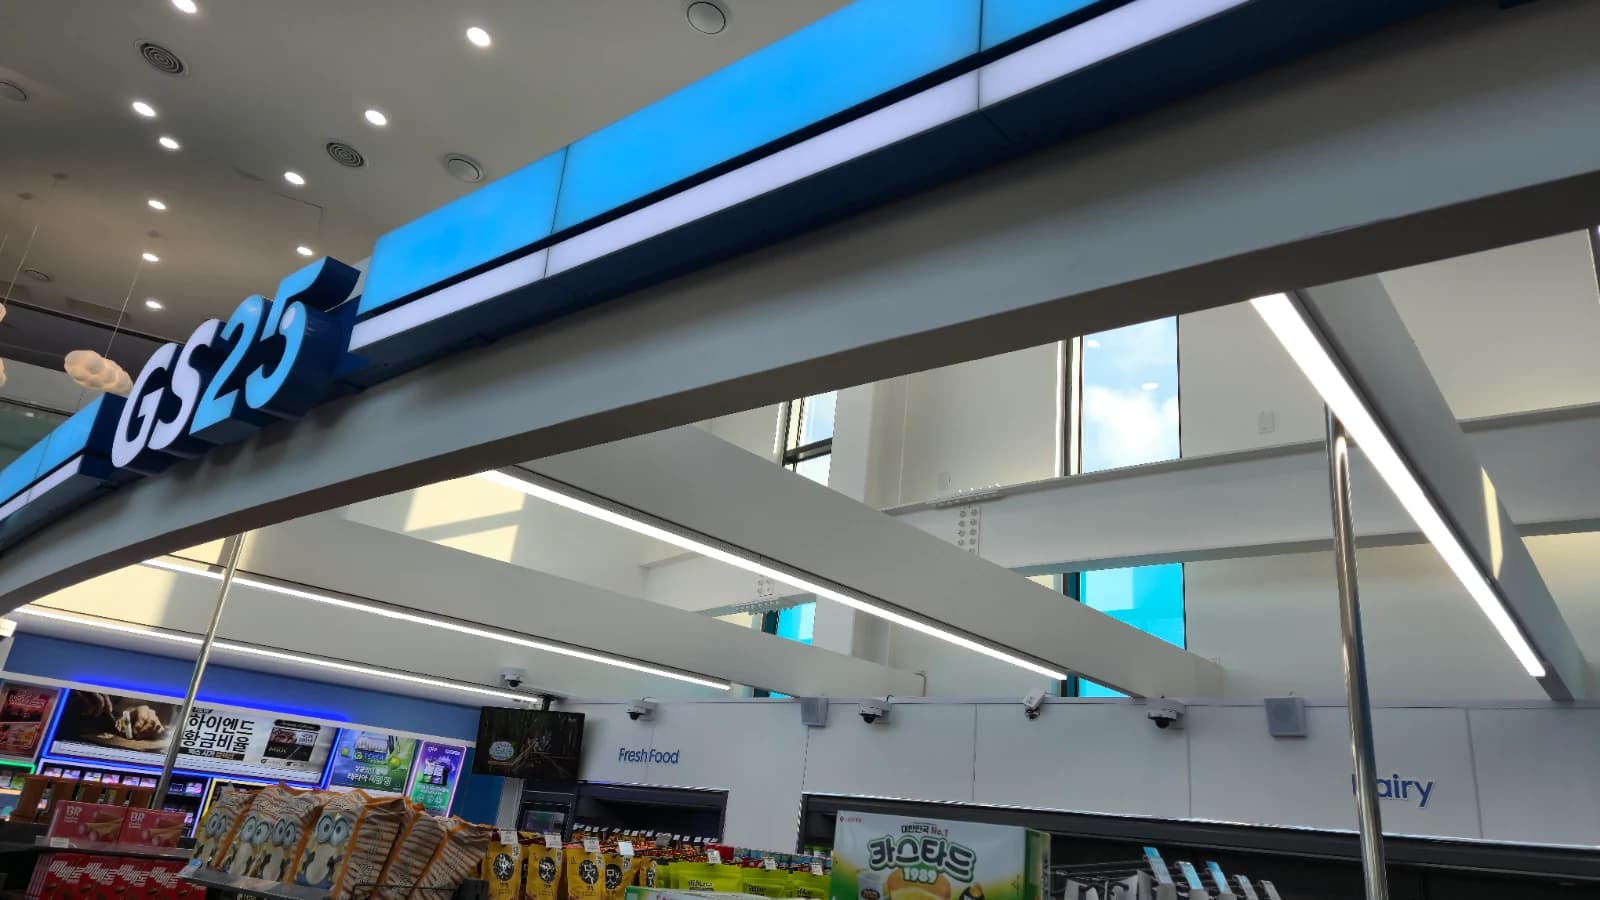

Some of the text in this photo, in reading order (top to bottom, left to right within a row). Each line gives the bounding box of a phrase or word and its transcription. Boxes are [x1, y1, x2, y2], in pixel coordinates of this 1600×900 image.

[112, 256, 328, 468] GS25
[189, 713, 255, 736] 하이엔드
[183, 730, 249, 753] 황금비율
[618, 747, 680, 764] Fresh Food
[1352, 773, 1433, 807] airy
[66, 805, 83, 817] BR
[130, 811, 146, 823] BR
[901, 824, 949, 837] 대한민국 No.1
[869, 836, 974, 879] 카스타드
[902, 866, 938, 884] 1989
